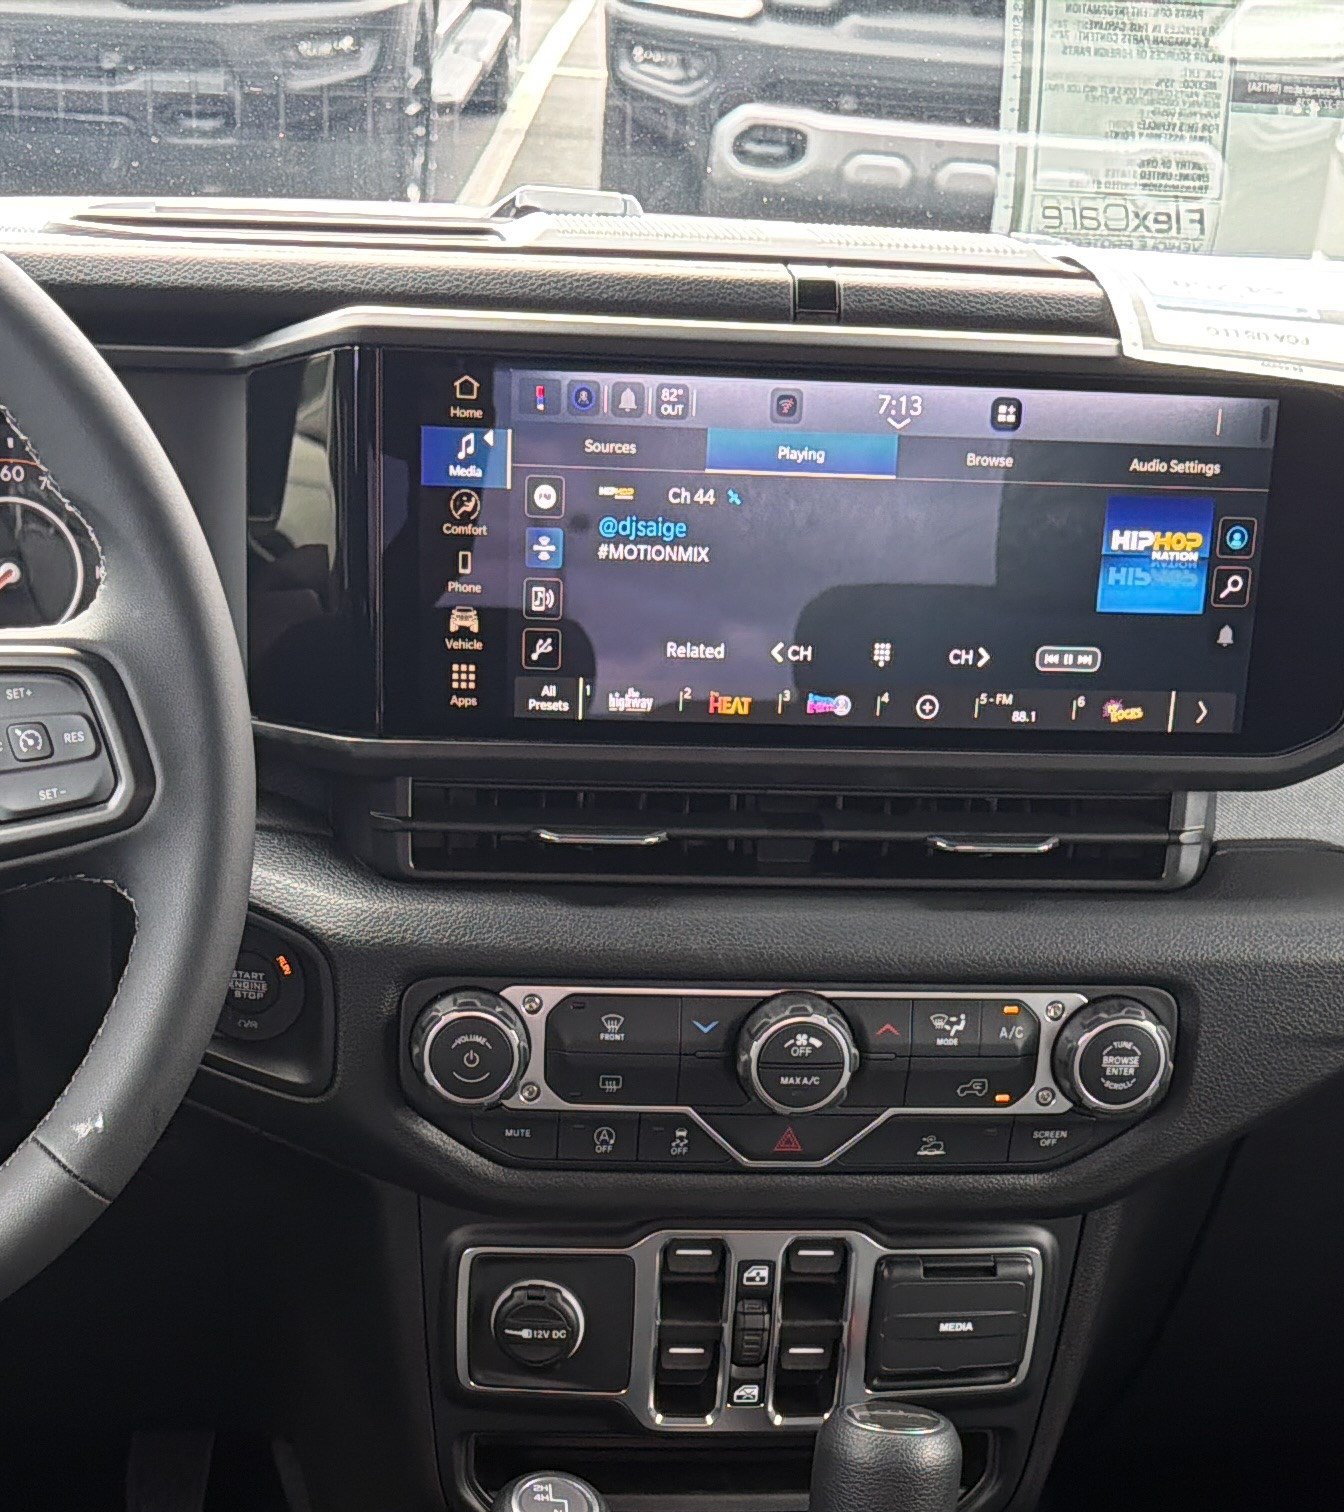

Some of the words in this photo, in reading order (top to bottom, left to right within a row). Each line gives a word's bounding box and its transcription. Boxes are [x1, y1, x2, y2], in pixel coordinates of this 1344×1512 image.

[661, 404, 684, 416] OUT
[878, 394, 923, 416] 7:13
[450, 406, 484, 420] Home
[584, 439, 637, 455] Sources
[777, 445, 826, 464] Playing
[966, 452, 1014, 468] Browse
[0, 465, 25, 482] 60
[448, 465, 483, 479] Media
[1129, 458, 1167, 473] Audio
[1169, 461, 1221, 477] Settings
[668, 488, 691, 505] Ch
[693, 488, 716, 505] 44
[442, 524, 488, 537] Comfort
[599, 516, 688, 542] @djsaige
[597, 545, 710, 564] #MOTIONMIX
[1151, 551, 1198, 562] NATION
[447, 581, 482, 594] Phone
[445, 638, 484, 651] Vehicle
[666, 641, 725, 660] Related
[787, 645, 813, 662] CH
[948, 649, 974, 666] CH
[540, 685, 557, 698] All
[450, 695, 477, 708] Apps
[528, 699, 570, 712] Presets
[709, 694, 753, 715] HEAT
[1011, 710, 1036, 723] 88.1
[63, 730, 85, 744] RES
[234, 990, 264, 1000] STOP
[599, 1033, 626, 1042] FRONT
[999, 1025, 1024, 1040] A/C
[455, 1033, 488, 1047] VOLUME
[936, 1037, 959, 1047] MODE
[1113, 1041, 1134, 1050] TUNE
[790, 1046, 813, 1058] OFF
[1102, 1055, 1141, 1065] BROWSE
[1106, 1067, 1135, 1076] ENTER
[780, 1076, 801, 1085] MAX
[802, 1076, 821, 1086] A/C
[1104, 1080, 1134, 1090] SCROLL
[505, 1128, 531, 1138] MUTE
[1032, 1130, 1068, 1140] SCREEN
[594, 1144, 613, 1154] OFF
[1040, 1138, 1058, 1147] OFF
[670, 1146, 689, 1155] OFF
[939, 1321, 973, 1333] MEDIA
[533, 1328, 550, 1340] 12V
[551, 1329, 567, 1341] DC
[533, 1493, 550, 1502] 4H
